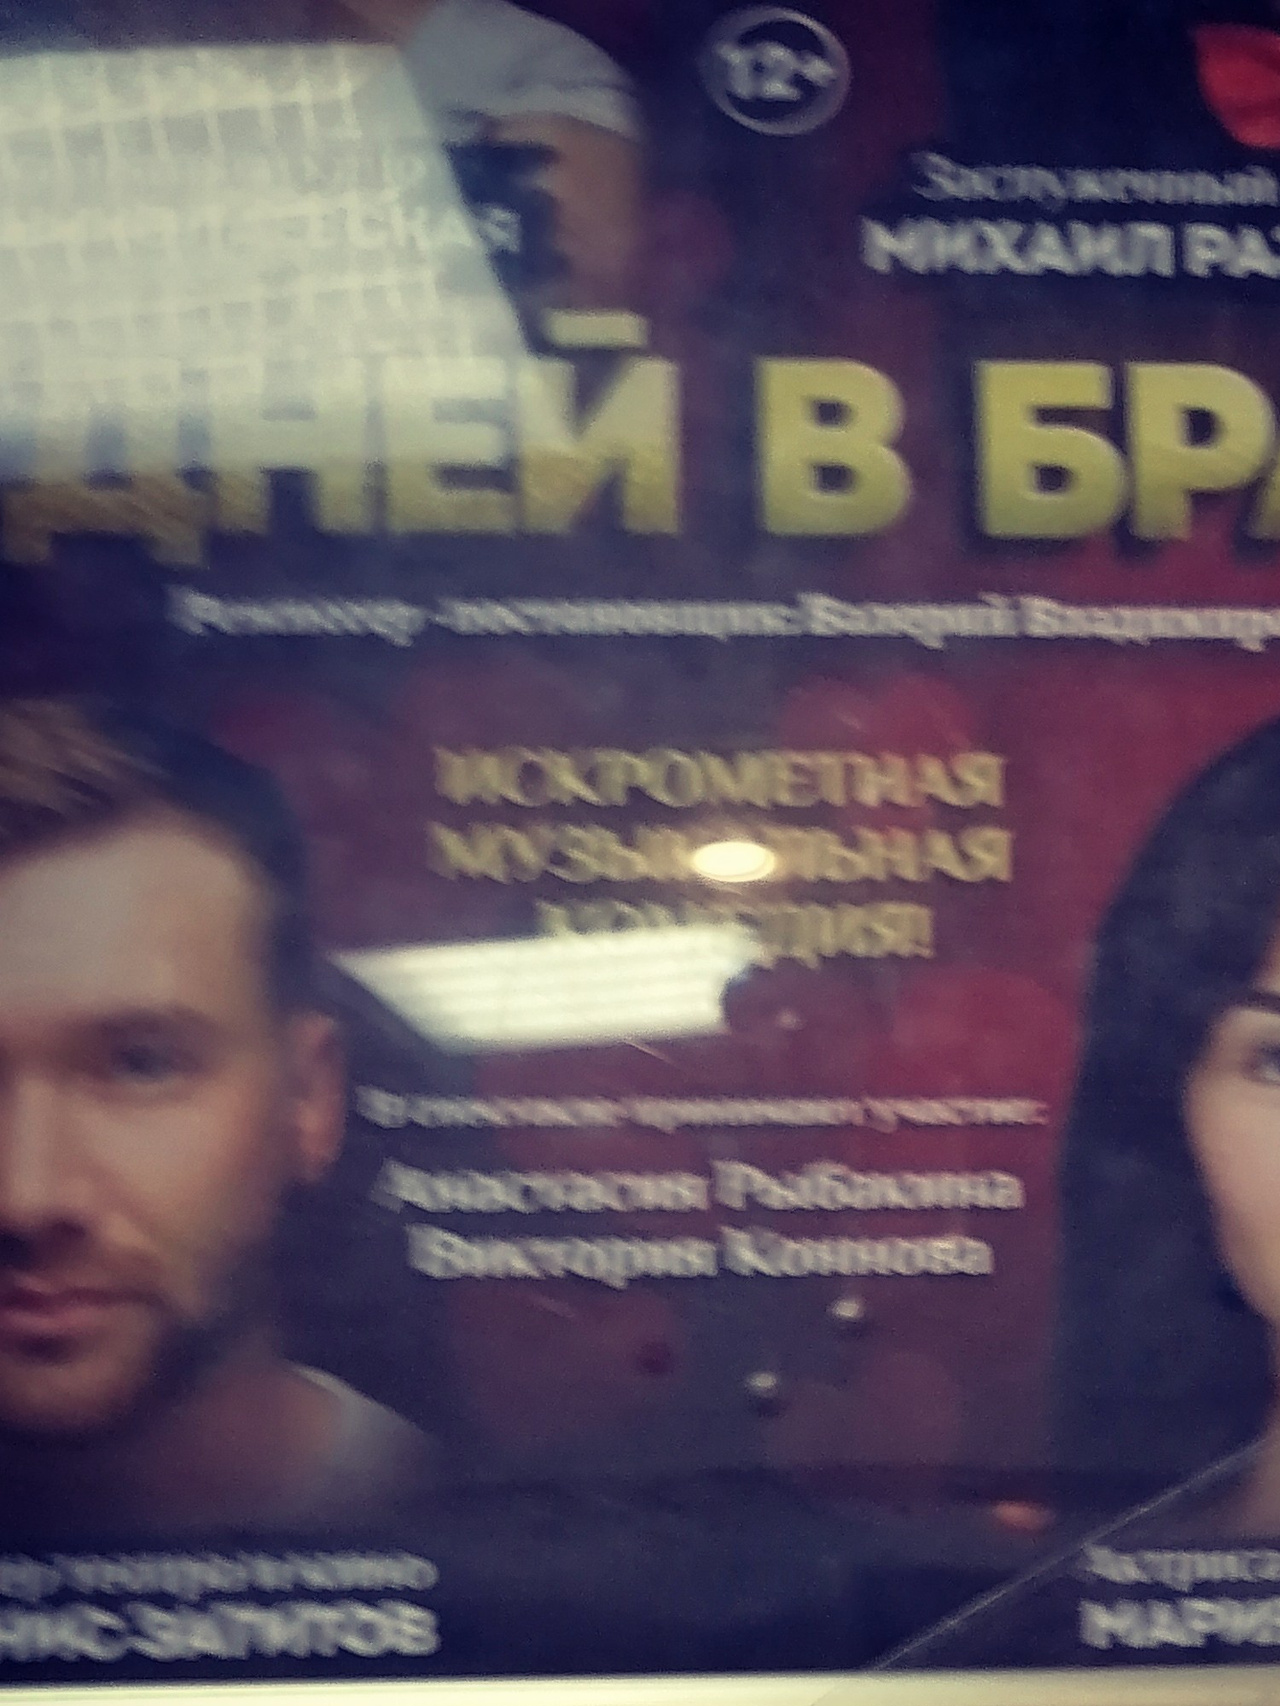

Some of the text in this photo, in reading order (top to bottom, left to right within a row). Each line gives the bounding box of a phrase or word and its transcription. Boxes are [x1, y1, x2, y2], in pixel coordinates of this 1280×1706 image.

[716, 42, 836, 101] 12+
[913, 150, 1279, 212] Заслуженный
[862, 216, 1176, 278] МИХАИЛ
[2, 308, 682, 572] ДНЕЙ
[757, 356, 912, 538] В
[432, 746, 1006, 809] ИСКРОМЕТНАЯ
[375, 1157, 1026, 1213] Анастасия Рыбакина
[404, 1222, 717, 1290] Виктория
